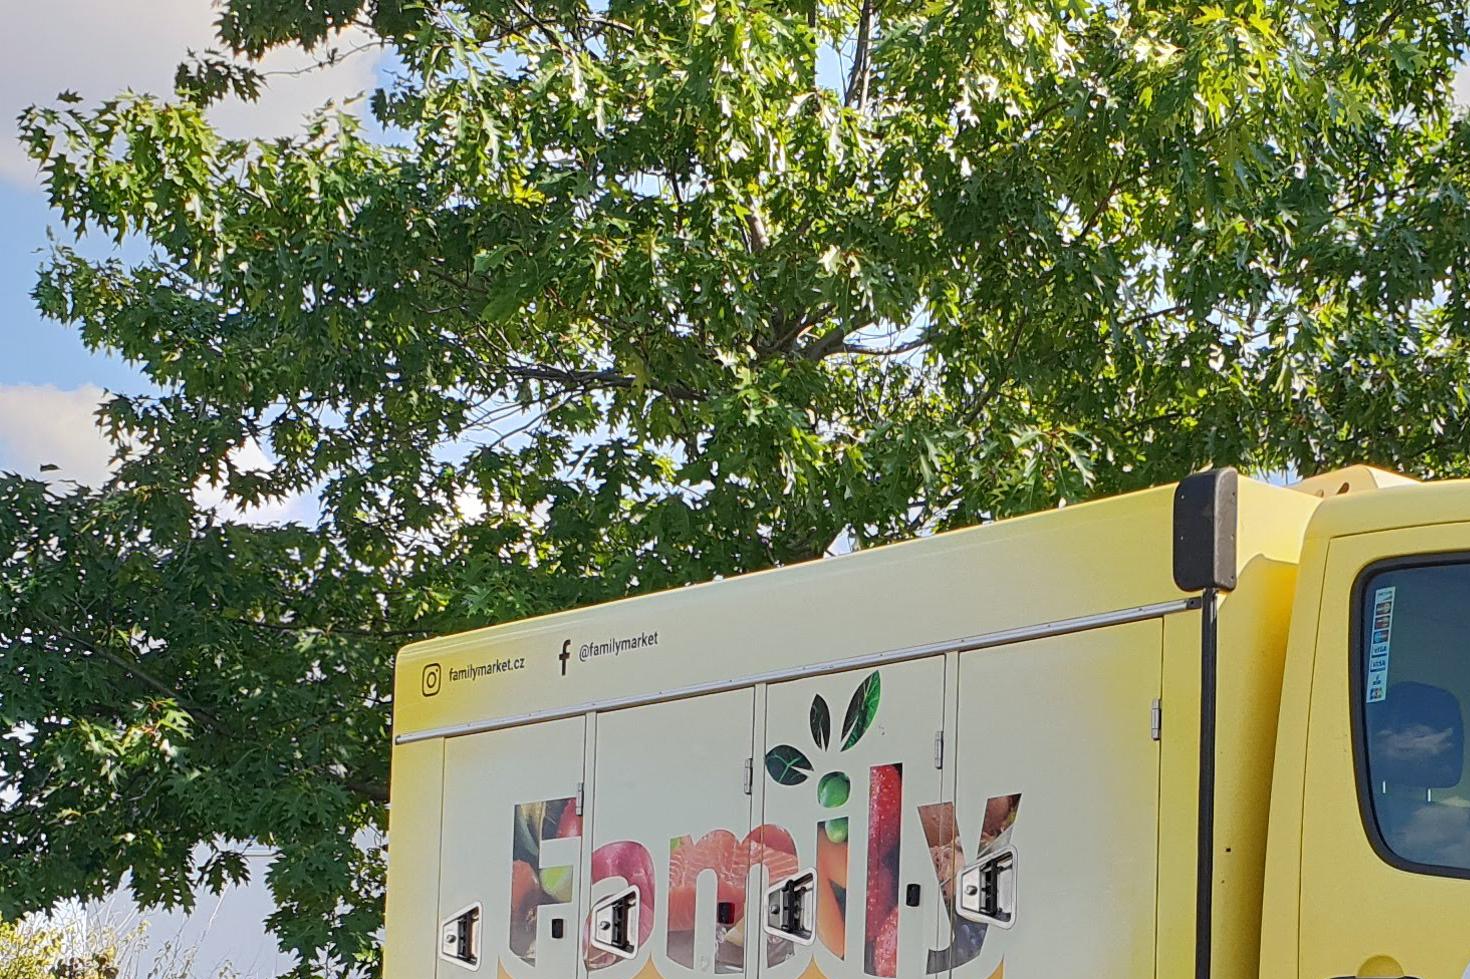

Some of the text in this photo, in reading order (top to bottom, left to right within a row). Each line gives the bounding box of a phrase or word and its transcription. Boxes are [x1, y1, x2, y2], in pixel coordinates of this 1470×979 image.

[579, 631, 658, 662] @familymarket
[449, 656, 526, 683] familymarket.cz
[509, 763, 1022, 977] Family
